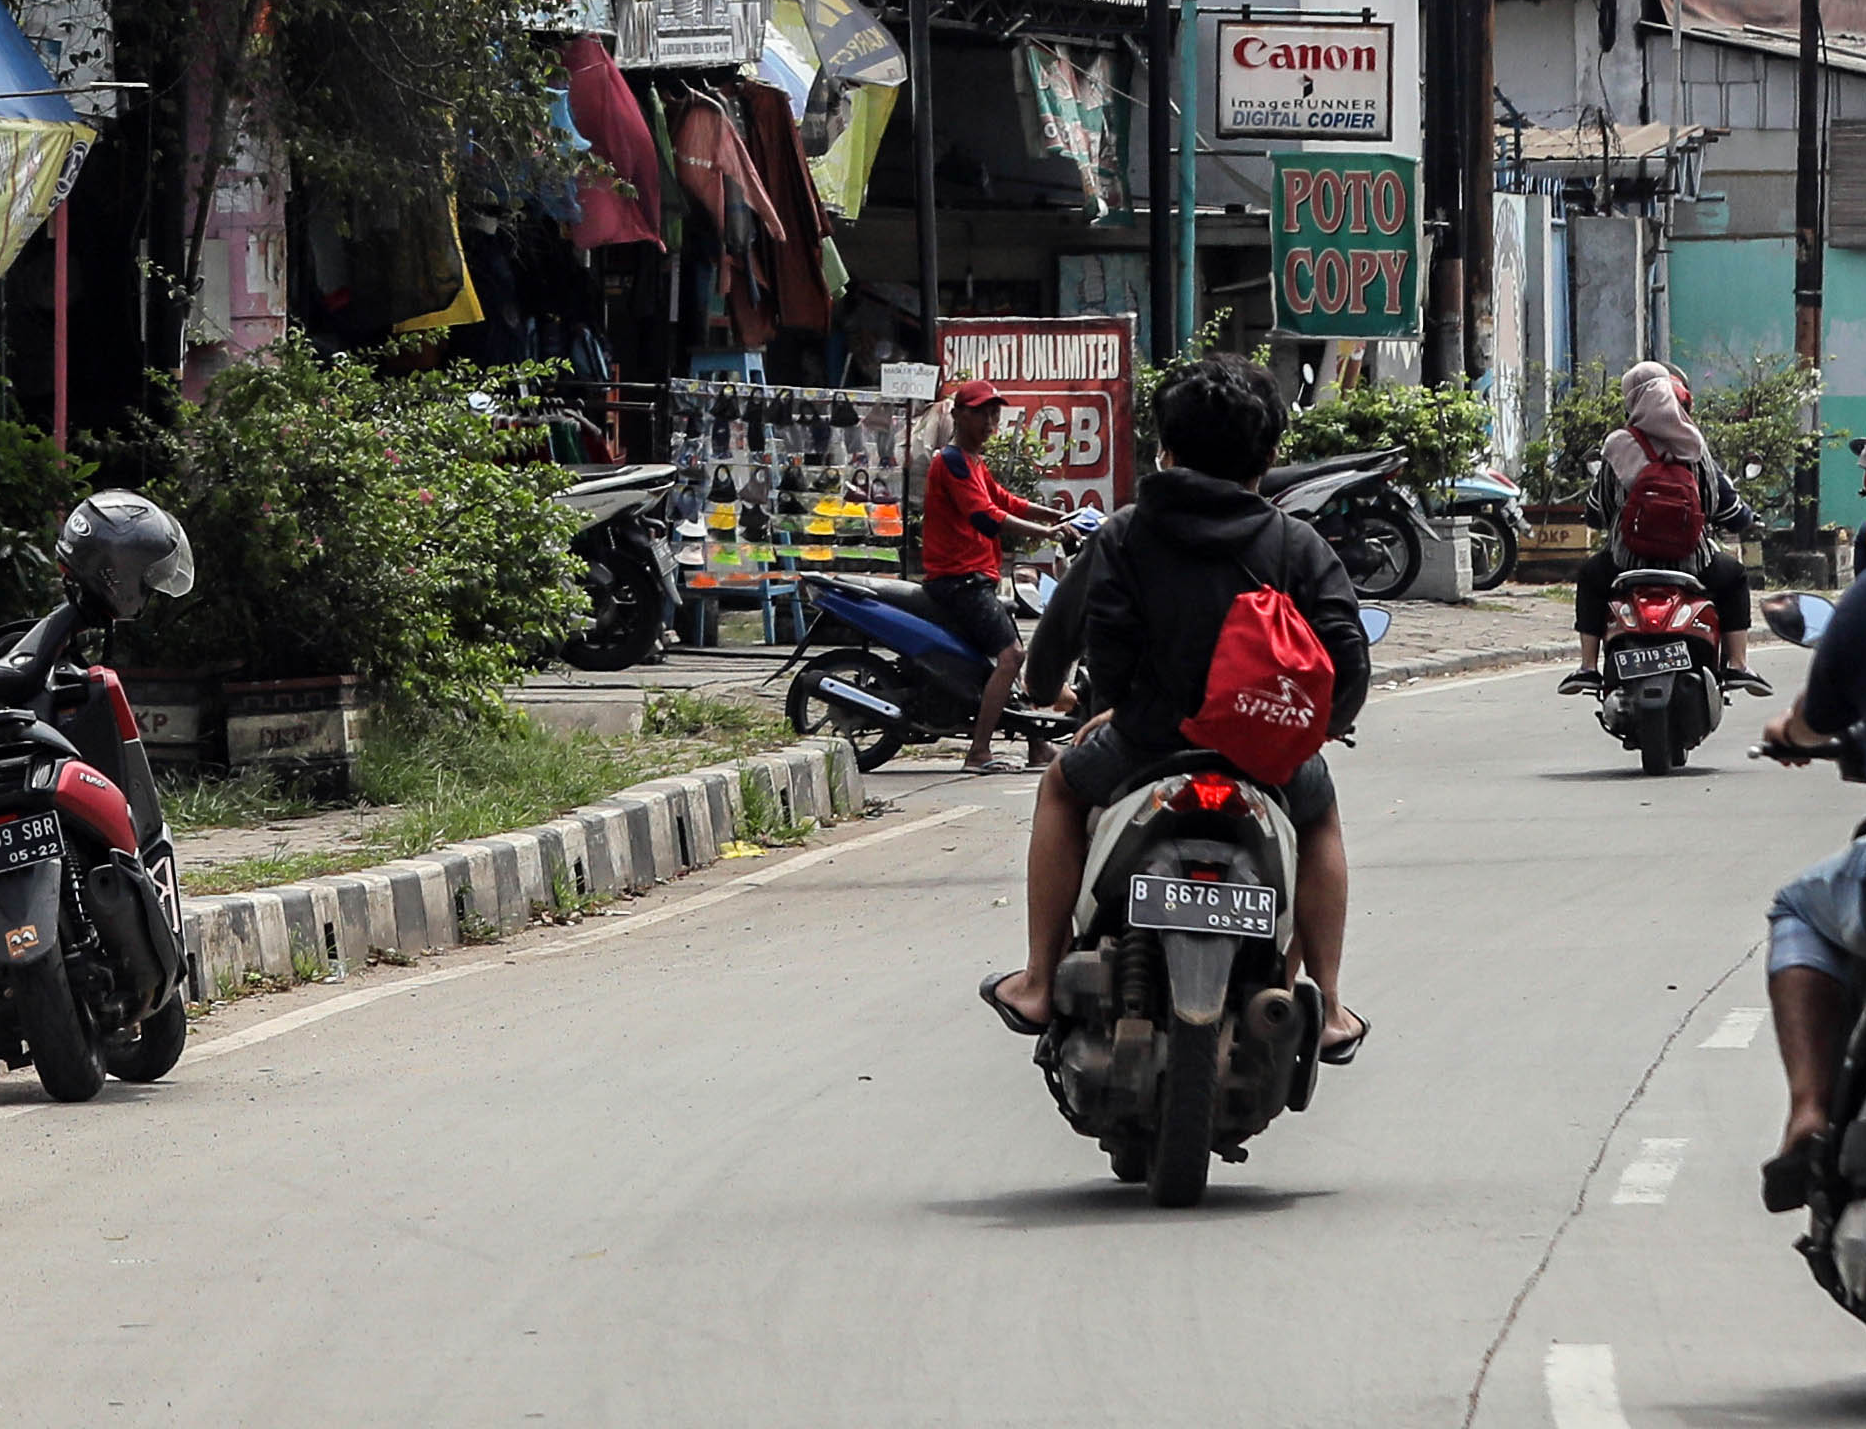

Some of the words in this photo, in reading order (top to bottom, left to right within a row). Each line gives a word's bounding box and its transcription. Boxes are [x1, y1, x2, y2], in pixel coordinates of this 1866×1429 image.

[1233, 36, 1376, 71] Canon
[1233, 110, 1302, 127] DIGITAL
[1308, 112, 1376, 129] COPIER
[1280, 166, 1407, 236] POTO
[1283, 247, 1409, 315] COPY
[943, 335, 1018, 382] SIMPATI
[1021, 334, 1120, 382] UNLIMITED
[134, 711, 168, 734] KP
[1233, 693, 1315, 729] SPECS
[22, 818, 55, 841] SBR
[1135, 881, 1148, 900] B
[1164, 883, 1220, 907] 6676
[1232, 890, 1271, 913] VLR
